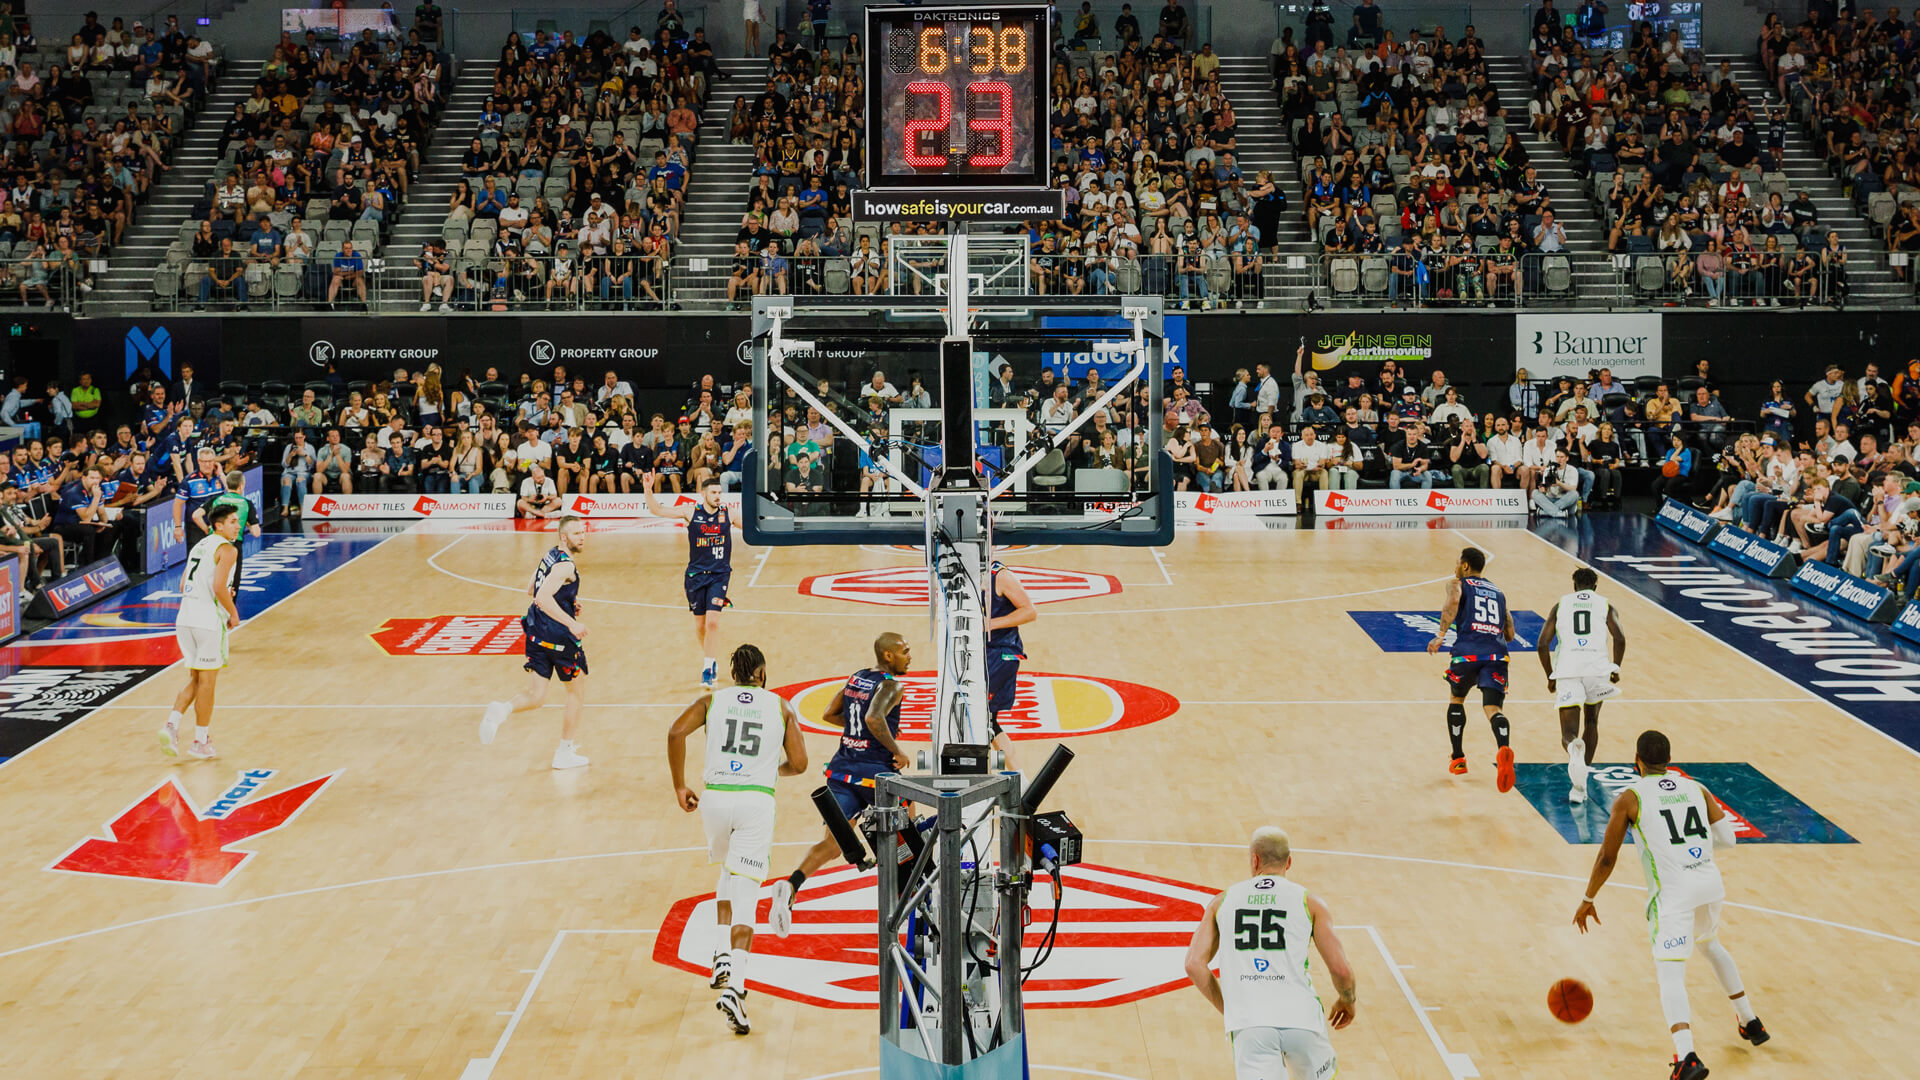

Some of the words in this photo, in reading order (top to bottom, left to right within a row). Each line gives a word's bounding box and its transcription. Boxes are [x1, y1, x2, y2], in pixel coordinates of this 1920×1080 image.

[914, 12, 1000, 21] DAKTRONICS
[920, 27, 1027, 74] 6:38
[905, 82, 1012, 166] 23
[864, 200, 1054, 218] howsafeisyourcar.com.au
[1318, 334, 1432, 348] JOHNSON
[1553, 330, 1648, 354] Banner
[340, 349, 397, 359] PROPERTY
[399, 349, 439, 359] GROUP
[560, 348, 617, 358] PROPERTY
[619, 348, 659, 358] GROUP
[826, 350, 866, 359] GROUP
[1350, 346, 1432, 358] earthmoving
[1553, 357, 1580, 367] Asset
[1582, 357, 1645, 369] Management
[321, 502, 380, 512] BEAUMONT
[383, 502, 405, 511] TILES
[422, 502, 480, 511] BEAUMONT
[484, 502, 507, 511] TILES
[580, 501, 640, 511] BEAUMONT
[1204, 499, 1261, 509] BEAUMONT
[1264, 499, 1288, 508] TILES
[1334, 497, 1392, 507] BEAUMONT
[1395, 497, 1418, 507] TILES
[1435, 497, 1493, 507] BEAUMONT
[1496, 497, 1519, 507] TILES
[1681, 510, 1710, 534] Harcourts
[696, 536, 725, 547] UNITED
[1714, 527, 1748, 552] Harcourts
[1743, 540, 1781, 566] Harcourts
[712, 547, 724, 559] 43
[188, 558, 201, 581] 7
[1796, 562, 1841, 592] Harcourts
[1835, 579, 1882, 610] Harcourts
[1474, 595, 1500, 625] 59
[1573, 610, 1591, 635] 0
[727, 706, 762, 719] WILLIAMS
[849, 703, 863, 737] 11
[721, 718, 763, 757] 15
[203, 770, 272, 817] mart
[1659, 806, 1708, 845] 14
[740, 856, 764, 869] TRADIE
[1247, 894, 1277, 905] CREEK
[1234, 908, 1287, 950] 55
[1663, 936, 1688, 949] GOAT
